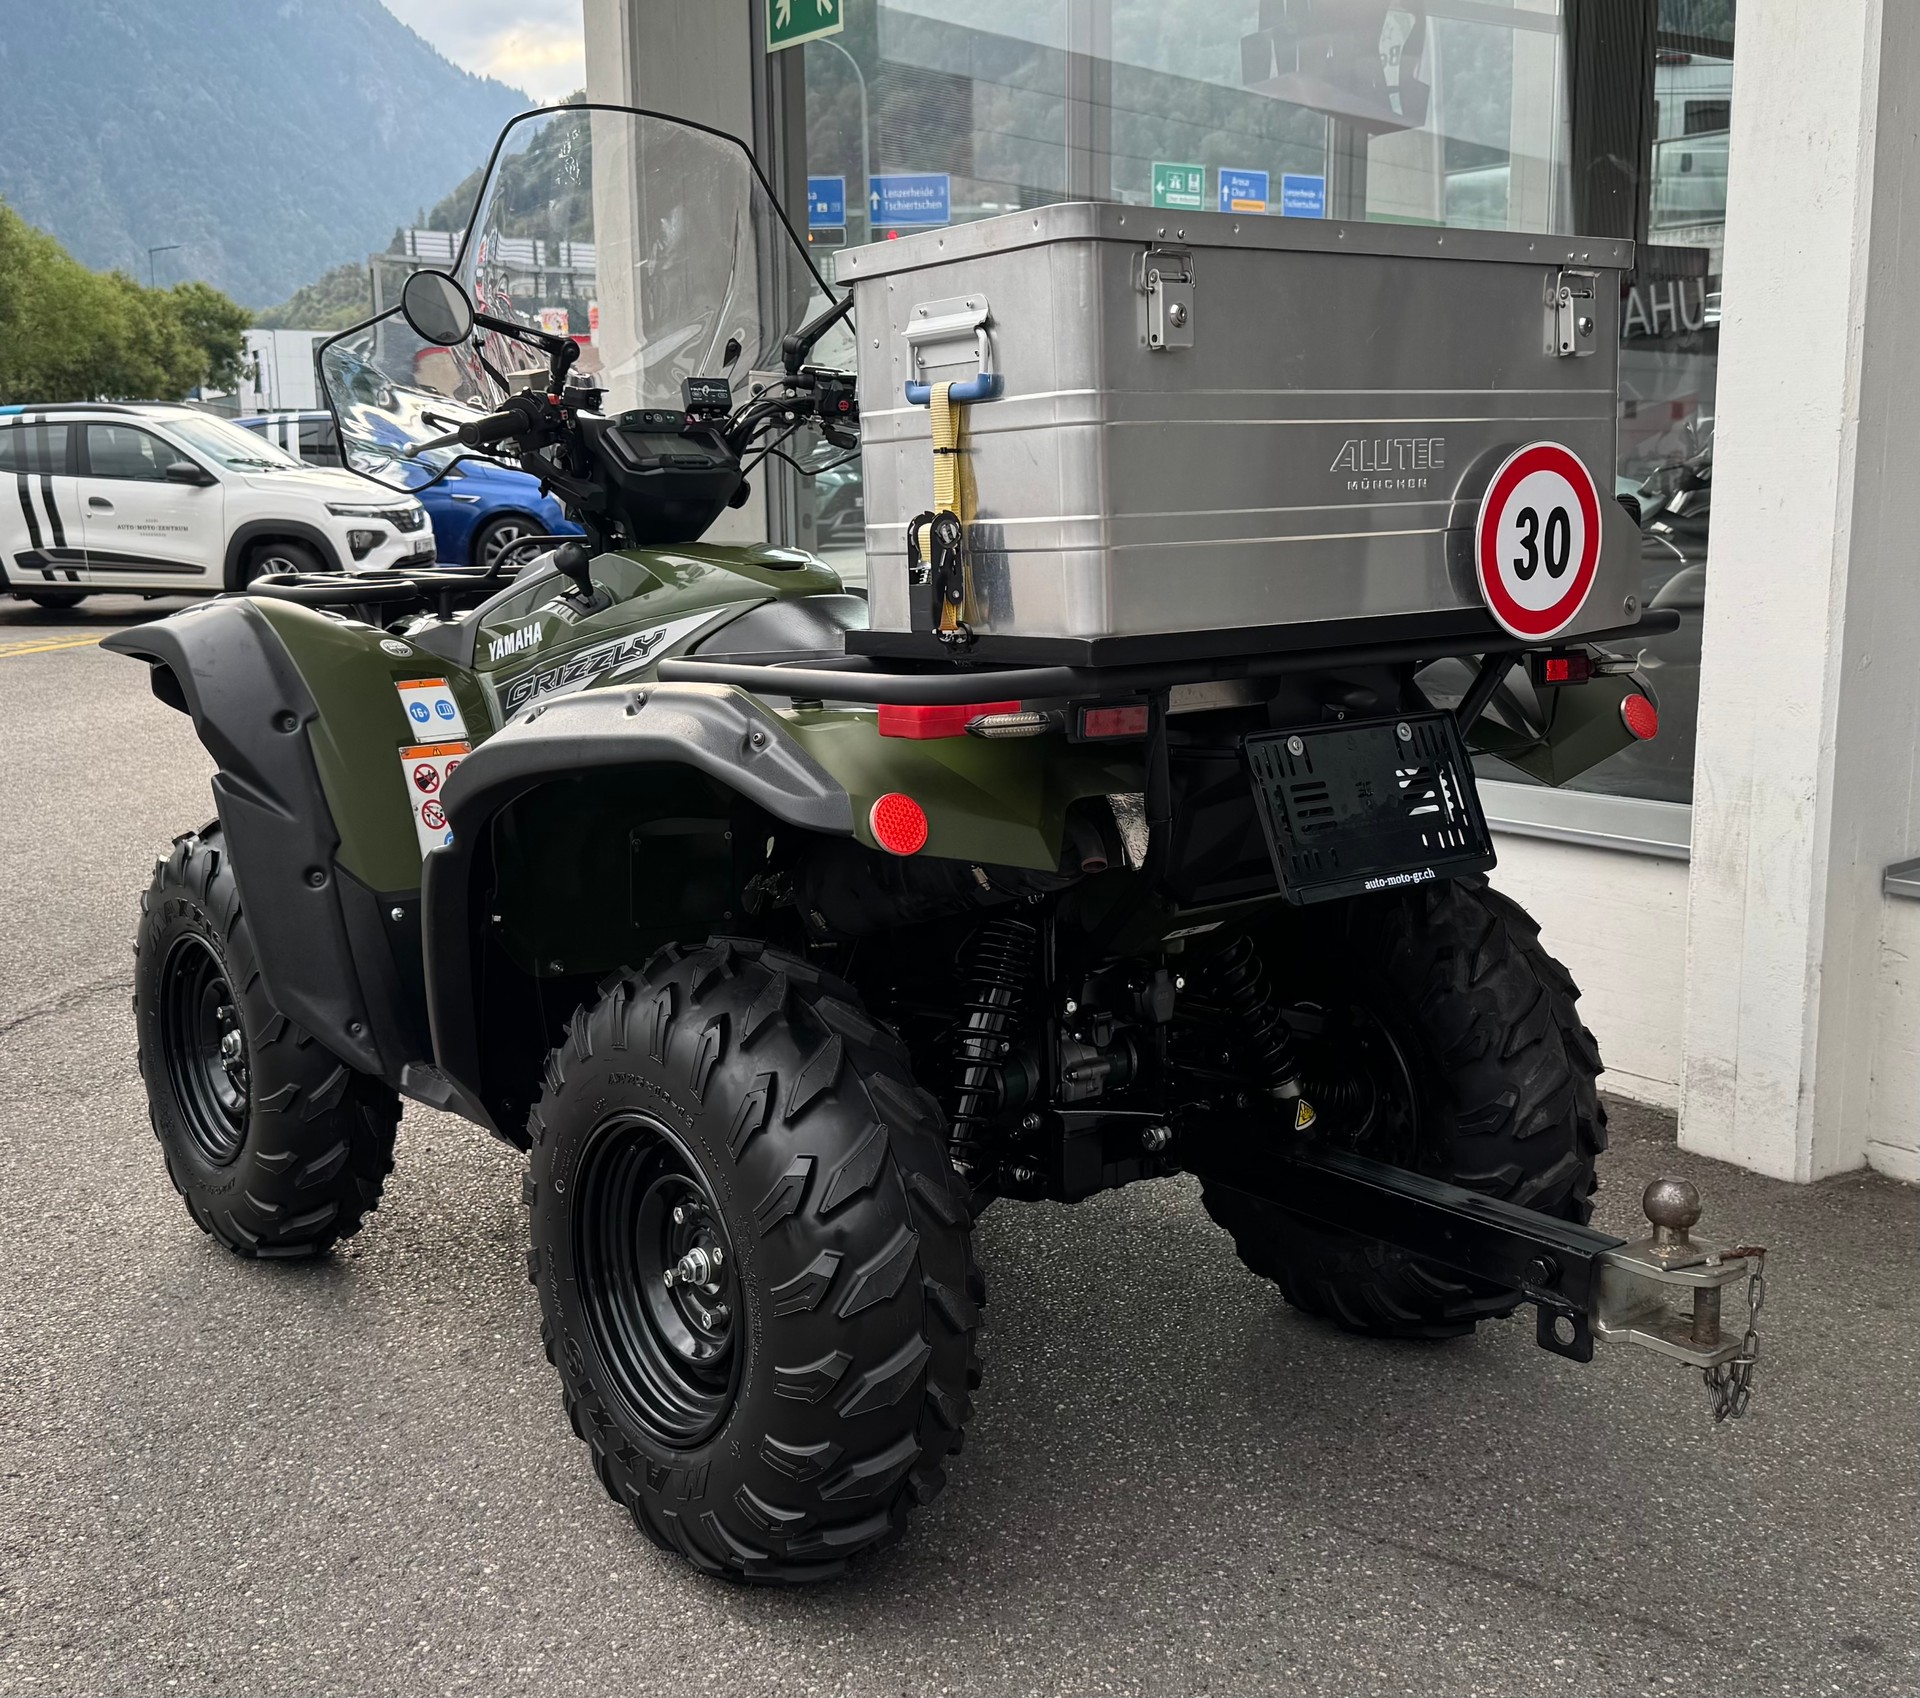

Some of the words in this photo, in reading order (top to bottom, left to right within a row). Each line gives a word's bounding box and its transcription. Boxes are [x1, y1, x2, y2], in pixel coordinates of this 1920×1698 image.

[883, 185, 935, 199] Lenzerheide
[1231, 189, 1247, 198] Chur
[885, 199, 943, 212] Tschiertschen
[1329, 437, 1445, 472] ALUTEC
[1347, 477, 1428, 491] MÜNCHEN
[1513, 506, 1571, 580] 30
[488, 621, 543, 662] YAMAHA
[506, 628, 668, 710] GRIZZLY
[410, 705, 429, 719] 16+
[563, 1337, 712, 1501] MAXXIS
